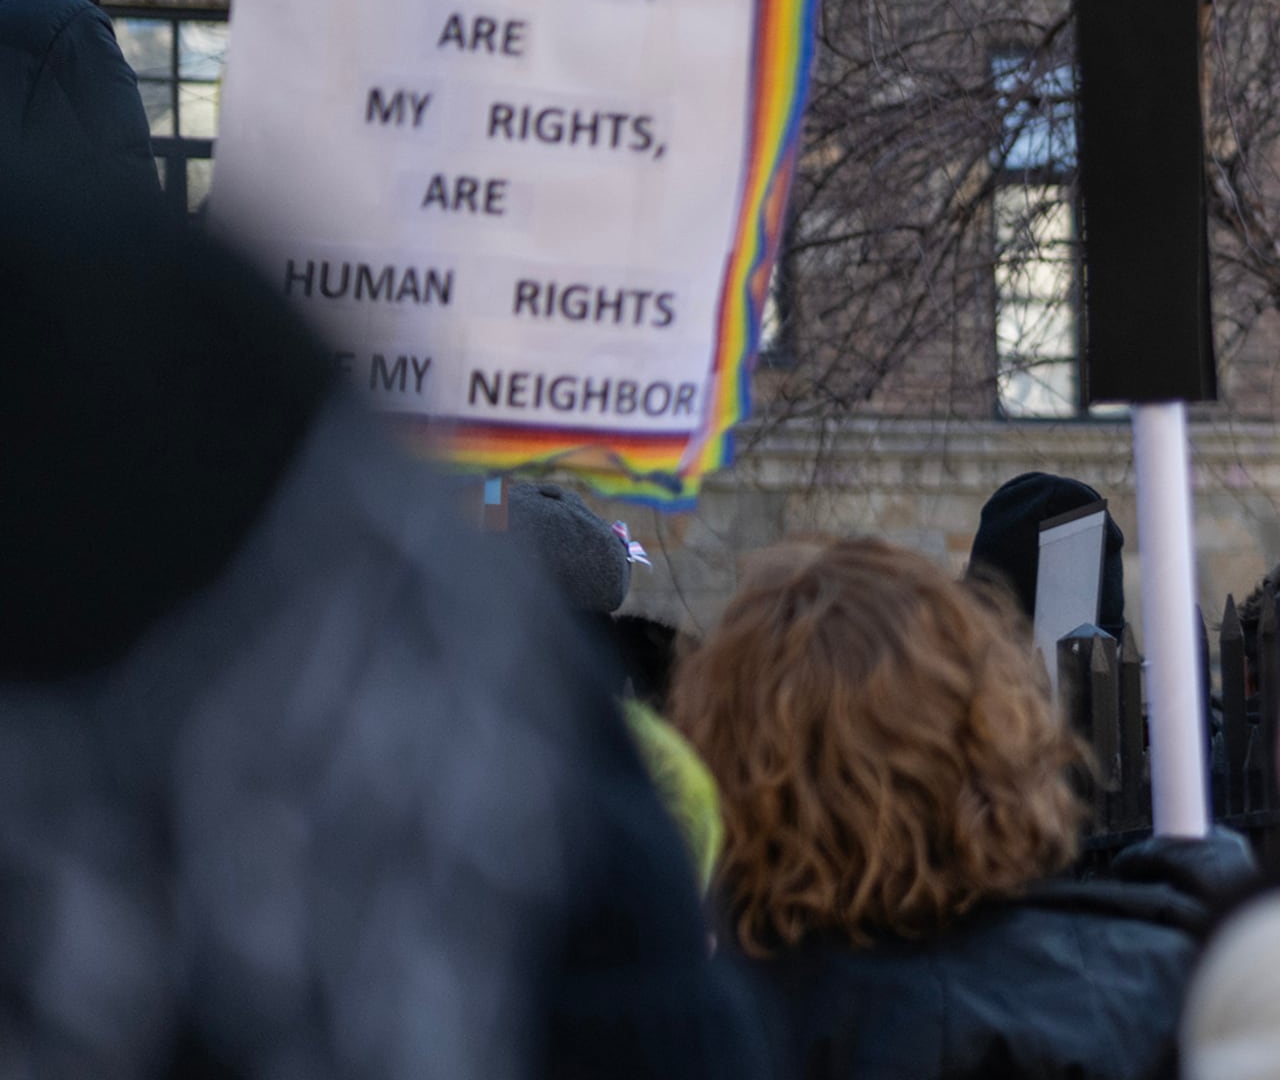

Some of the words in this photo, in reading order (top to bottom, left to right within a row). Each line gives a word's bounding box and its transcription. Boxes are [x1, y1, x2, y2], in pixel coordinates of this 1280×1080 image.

[437, 12, 528, 58] ARE
[364, 86, 433, 128] MY
[486, 101, 668, 160] RIGHTS,
[420, 173, 510, 217] ARE
[284, 259, 455, 307] HUMAN
[512, 277, 676, 329] RIGHTS
[369, 353, 432, 394] MY
[467, 368, 696, 417] NEIGHBOR
